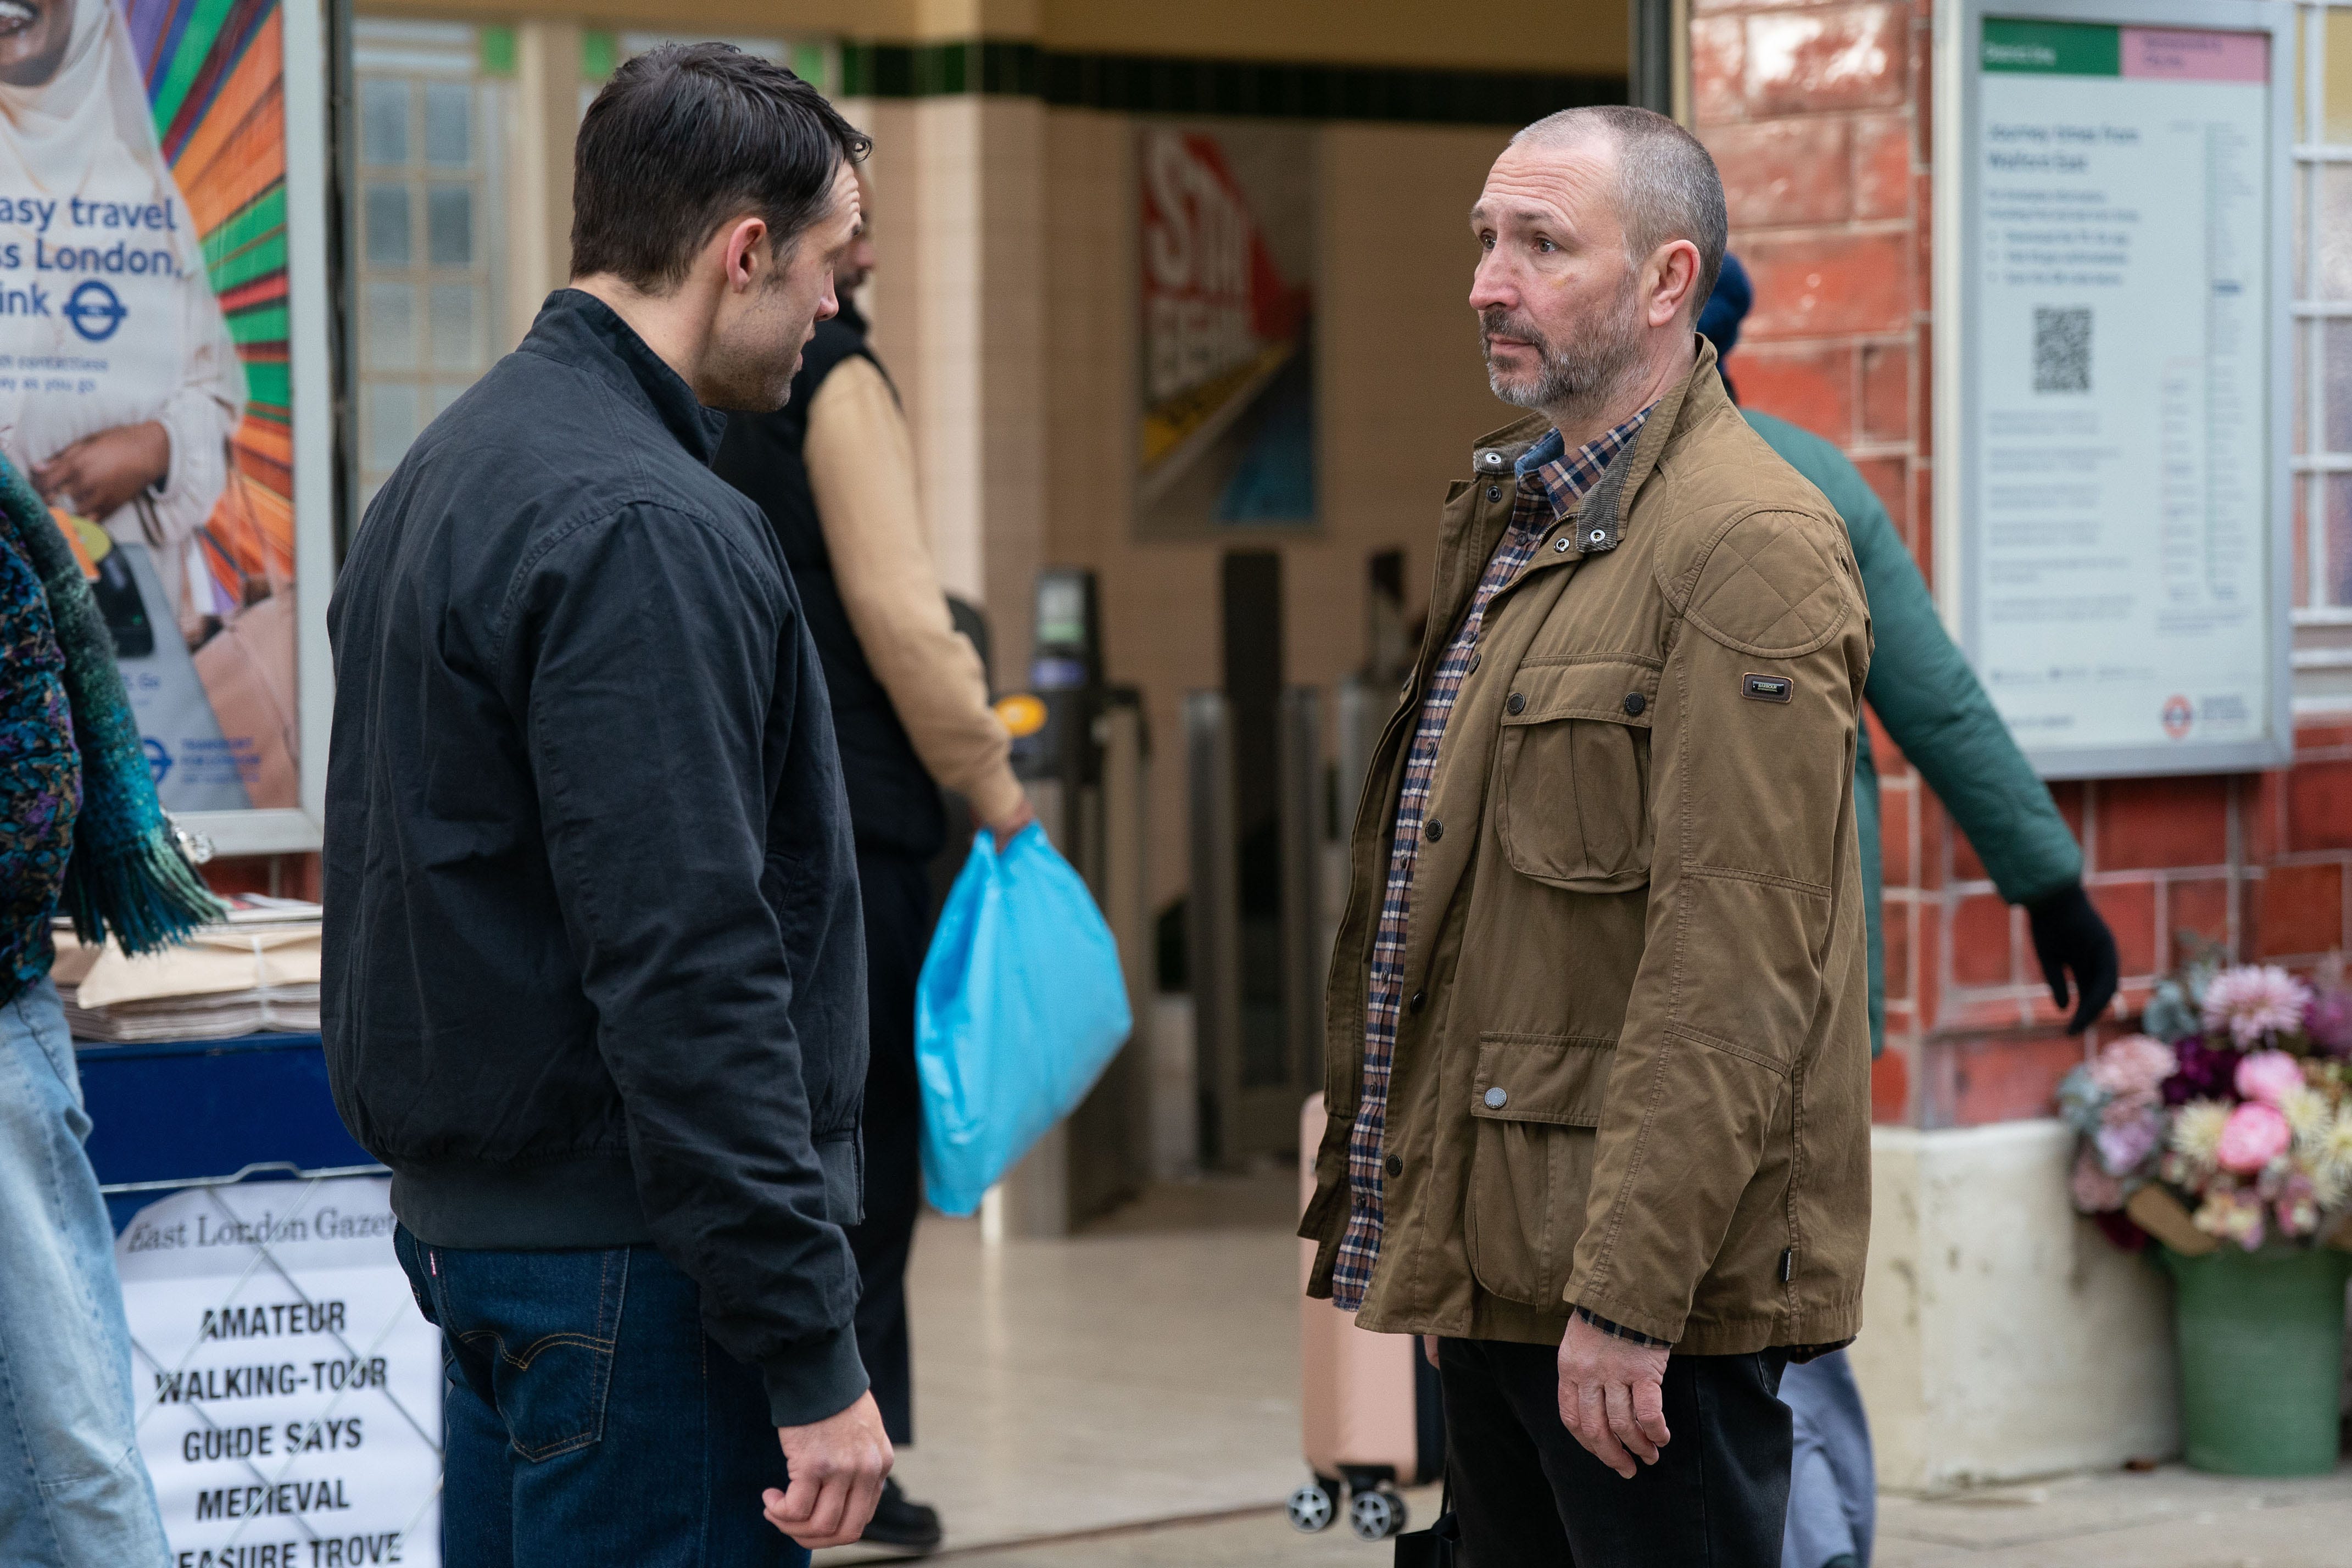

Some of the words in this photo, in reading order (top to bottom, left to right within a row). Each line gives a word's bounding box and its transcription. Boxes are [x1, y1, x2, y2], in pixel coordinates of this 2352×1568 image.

[72, 196, 176, 230] travel
[36, 238, 182, 278] London,
[128, 1220, 186, 1253] East
[198, 1212, 309, 1247] London
[201, 1301, 345, 1340] AMATEUR
[156, 1358, 387, 1403] WALKING-TOUR
[183, 1425, 274, 1462] GUIDE
[285, 1418, 362, 1453] SAYS
[197, 1478, 350, 1521] MEDIEVAL
[171, 1542, 298, 1568] EASURE
[309, 1532, 404, 1568] TROVE
